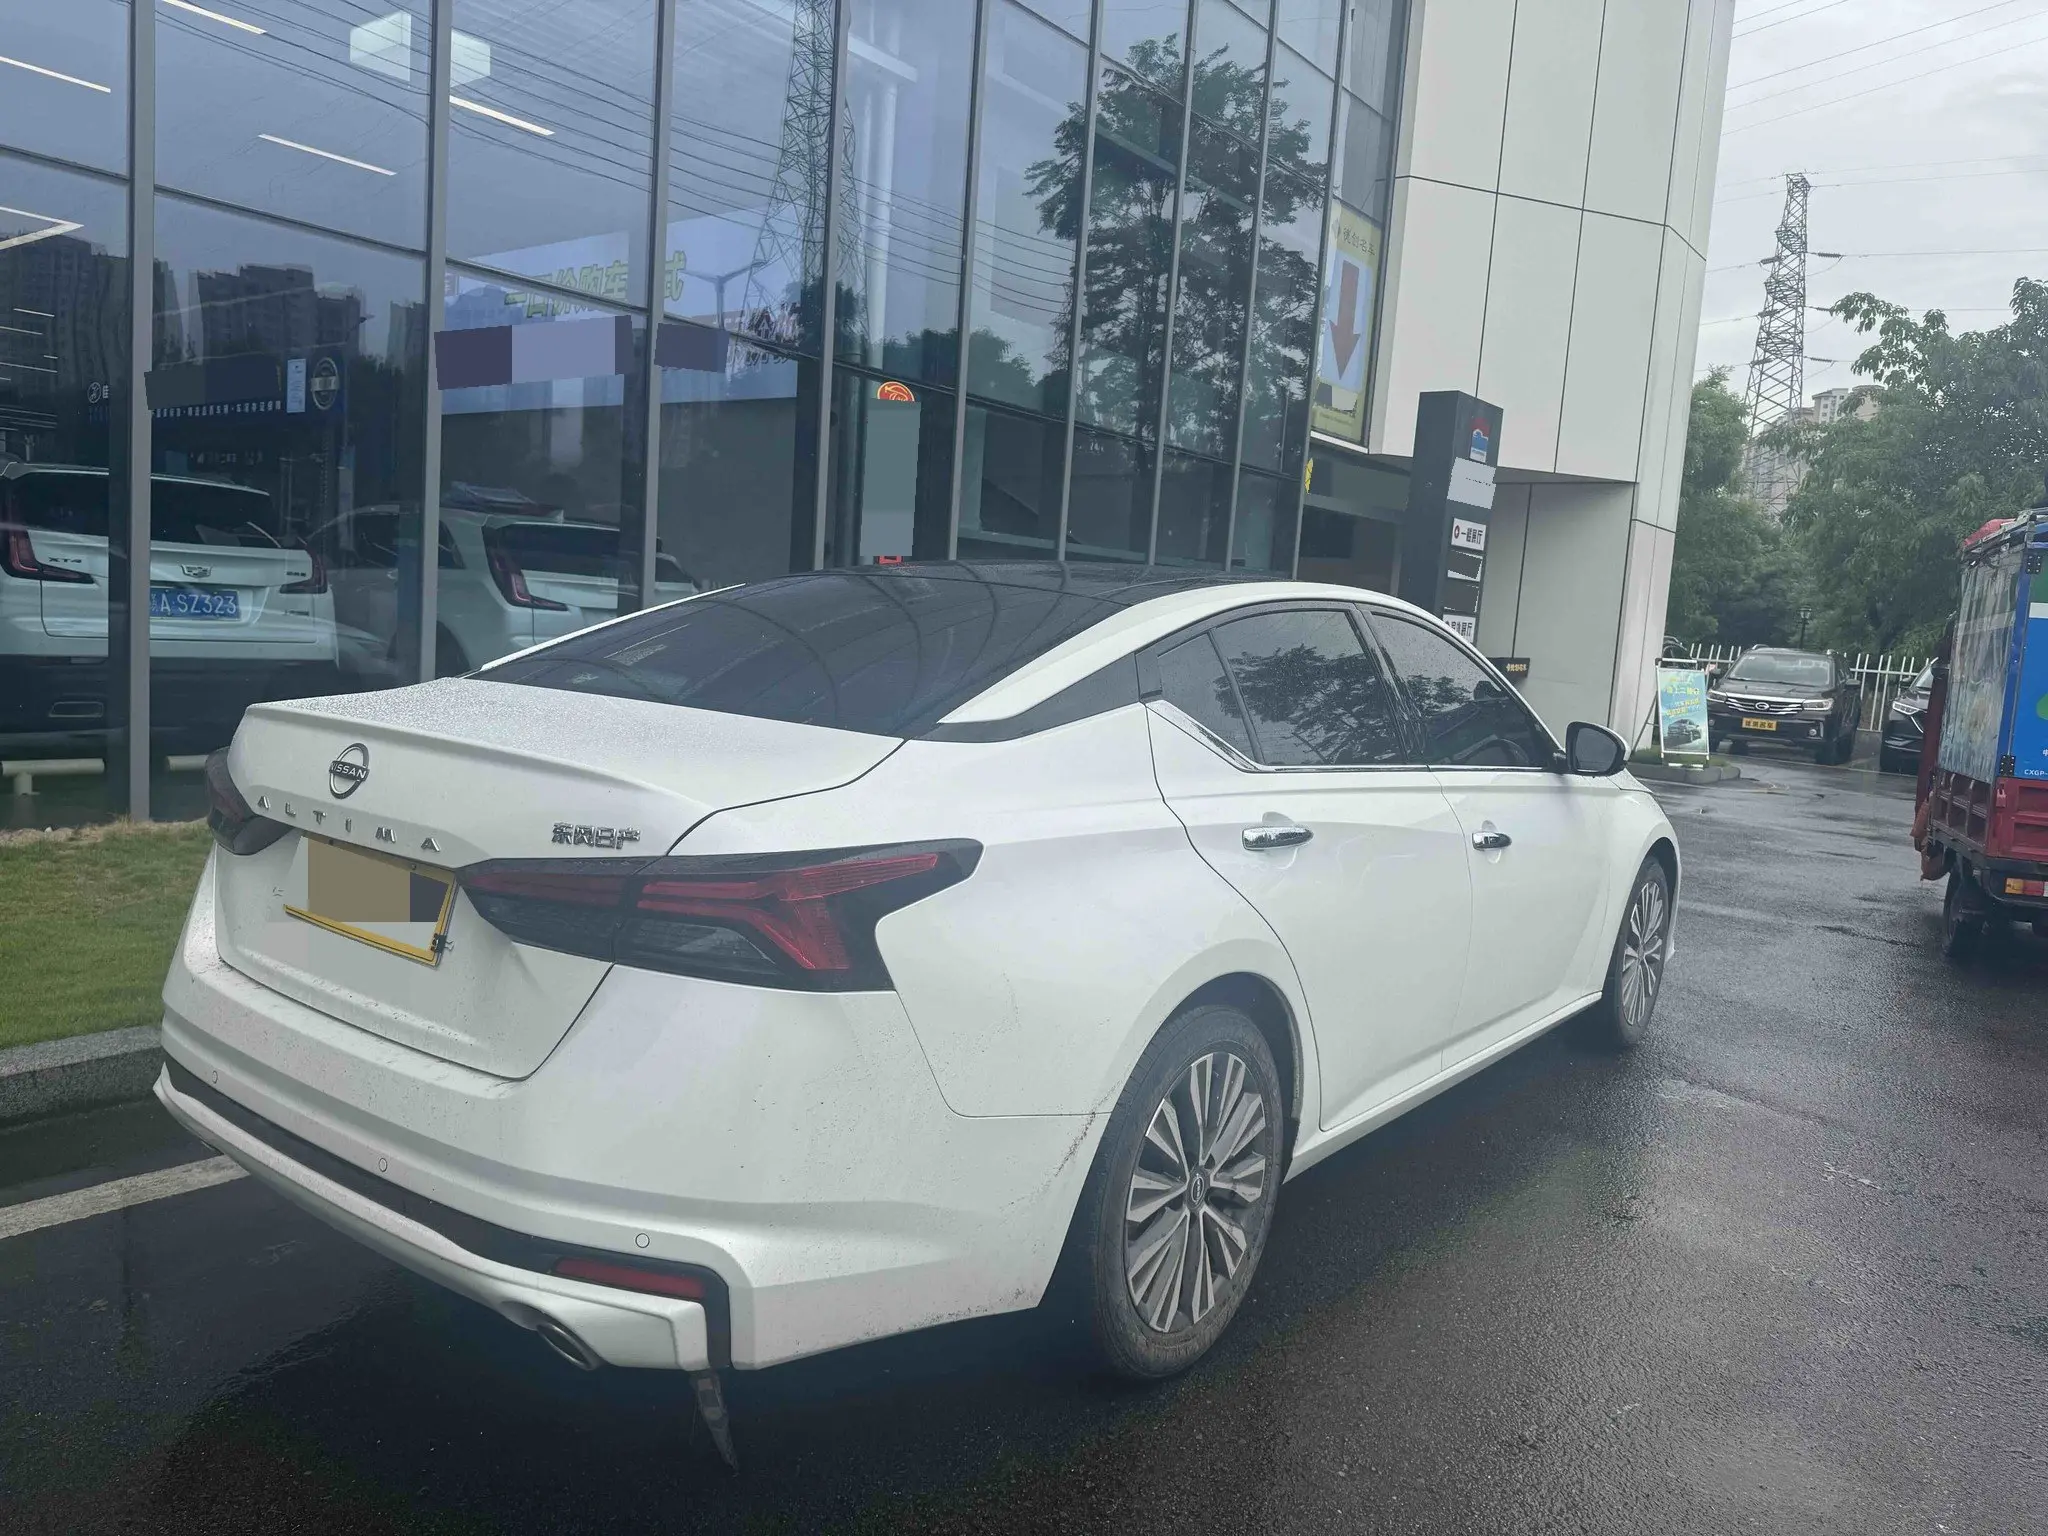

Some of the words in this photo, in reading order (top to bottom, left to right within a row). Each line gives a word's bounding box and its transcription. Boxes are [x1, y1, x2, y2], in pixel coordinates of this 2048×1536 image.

[504, 250, 687, 318] 一口价购车式
[331, 763, 367, 779] NISSAN
[257, 796, 441, 852] ALTIMA
[551, 822, 641, 849] 东风日产
